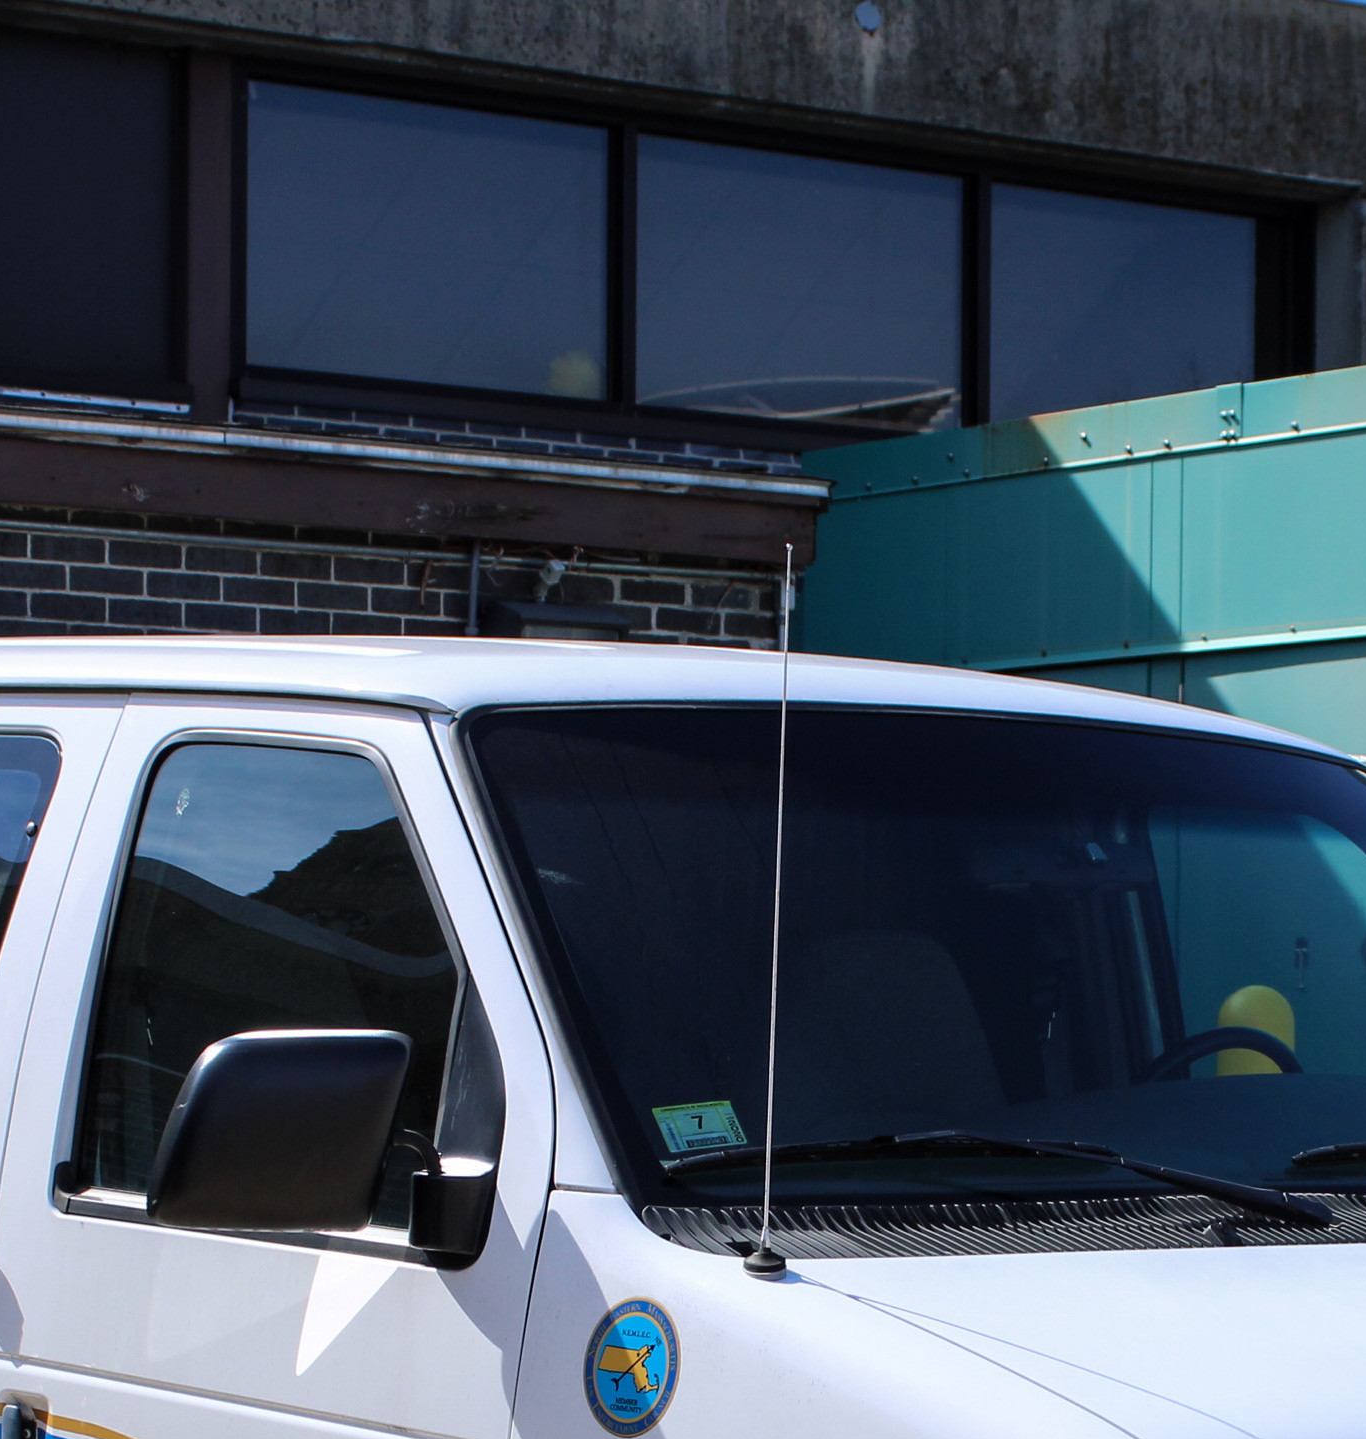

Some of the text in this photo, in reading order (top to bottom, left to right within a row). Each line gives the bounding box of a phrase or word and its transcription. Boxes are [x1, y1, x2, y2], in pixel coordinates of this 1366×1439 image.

[690, 1114, 703, 1130] 7
[615, 1397, 638, 1406] MEMBER
[609, 1402, 643, 1414] COMMUNITY
